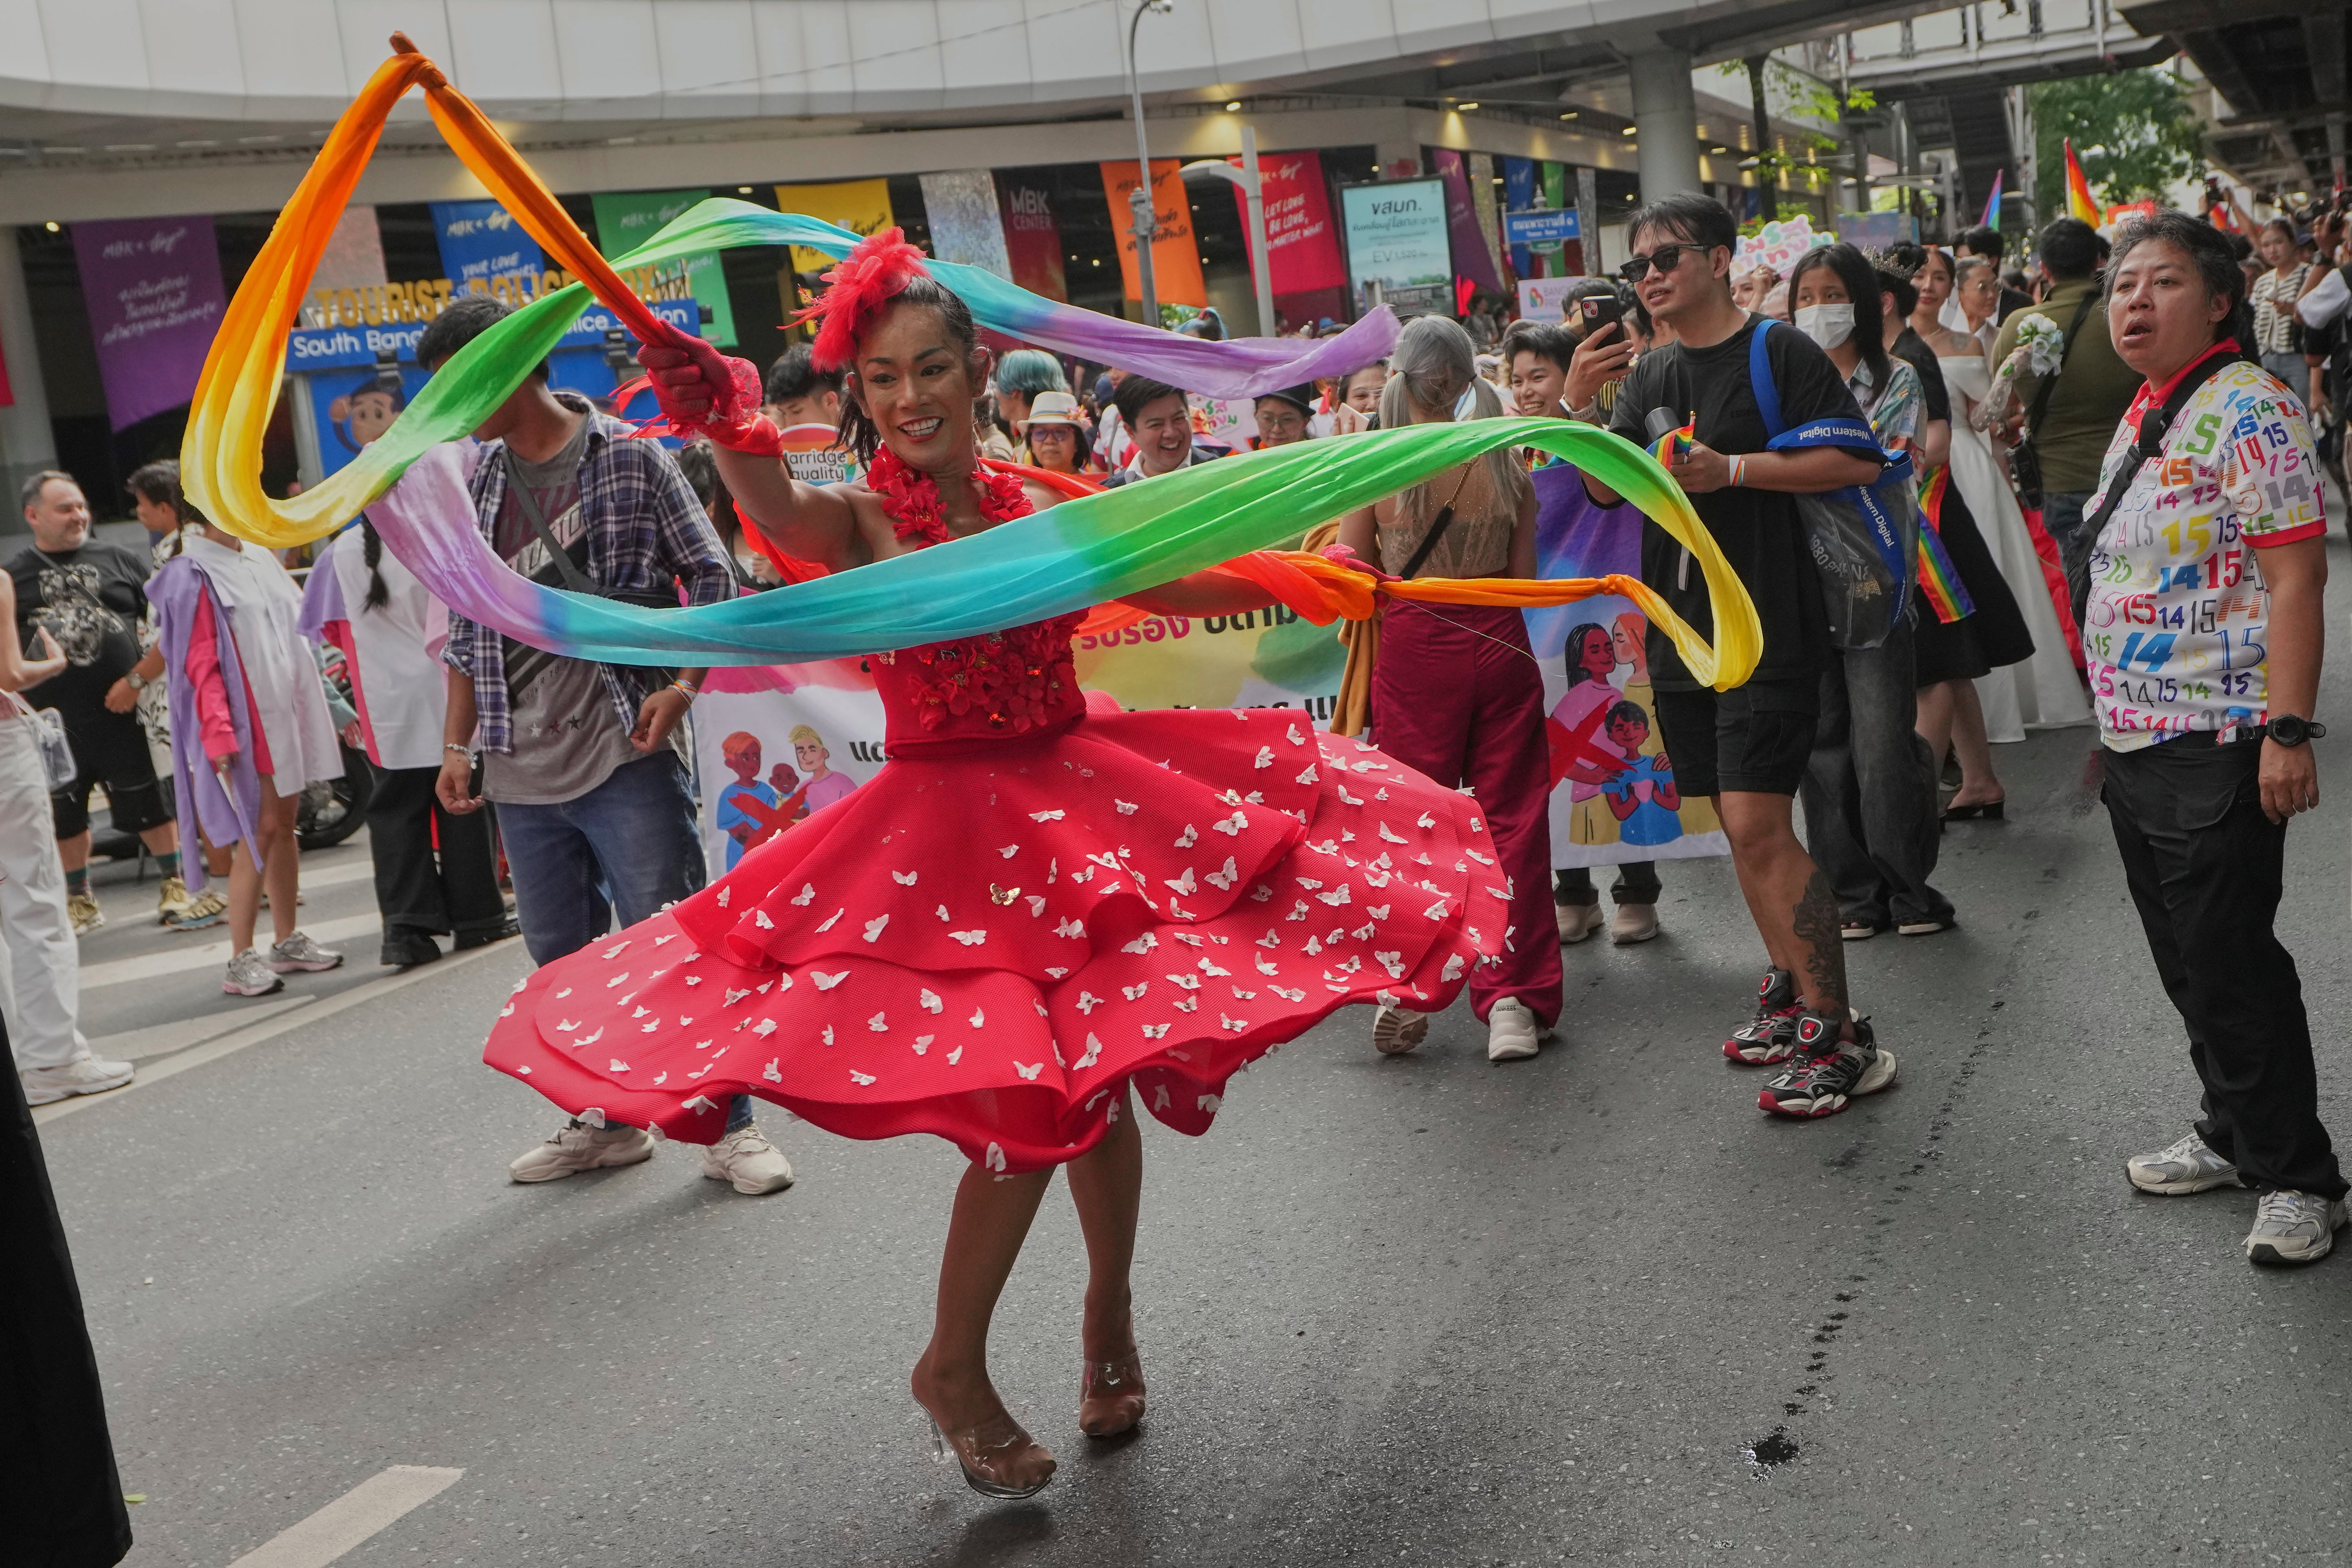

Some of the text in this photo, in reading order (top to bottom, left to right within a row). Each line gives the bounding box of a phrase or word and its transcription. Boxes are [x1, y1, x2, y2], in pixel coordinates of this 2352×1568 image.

[1010, 186, 1050, 214] MBK
[1265, 193, 1305, 218] LET LOVE
[1013, 215, 1053, 230] CENTER
[315, 278, 452, 329] TOURIST
[293, 331, 361, 358] South
[2197, 389, 2218, 408] 15
[1833, 427, 1871, 441] Western
[2174, 412, 2223, 455] 15
[2232, 414, 2259, 440] 15
[2262, 421, 2289, 448] 15
[785, 450, 846, 466] arriage
[2160, 457, 2194, 486] 15
[2270, 447, 2299, 477] 15
[2155, 491, 2180, 510] 14
[2265, 473, 2310, 510] 14
[2161, 513, 2213, 558] 15
[2216, 514, 2238, 545] 15
[2159, 563, 2203, 594] 14
[2204, 549, 2243, 589] 15
[2115, 593, 2157, 625] 15
[2158, 606, 2185, 629] 14
[2191, 599, 2217, 635] 15
[2118, 632, 2178, 672] 14
[2181, 648, 2208, 668] 15
[2213, 625, 2265, 671] 15
[2120, 680, 2155, 708] 14
[2155, 678, 2177, 702] 15
[2182, 681, 2211, 700] 14
